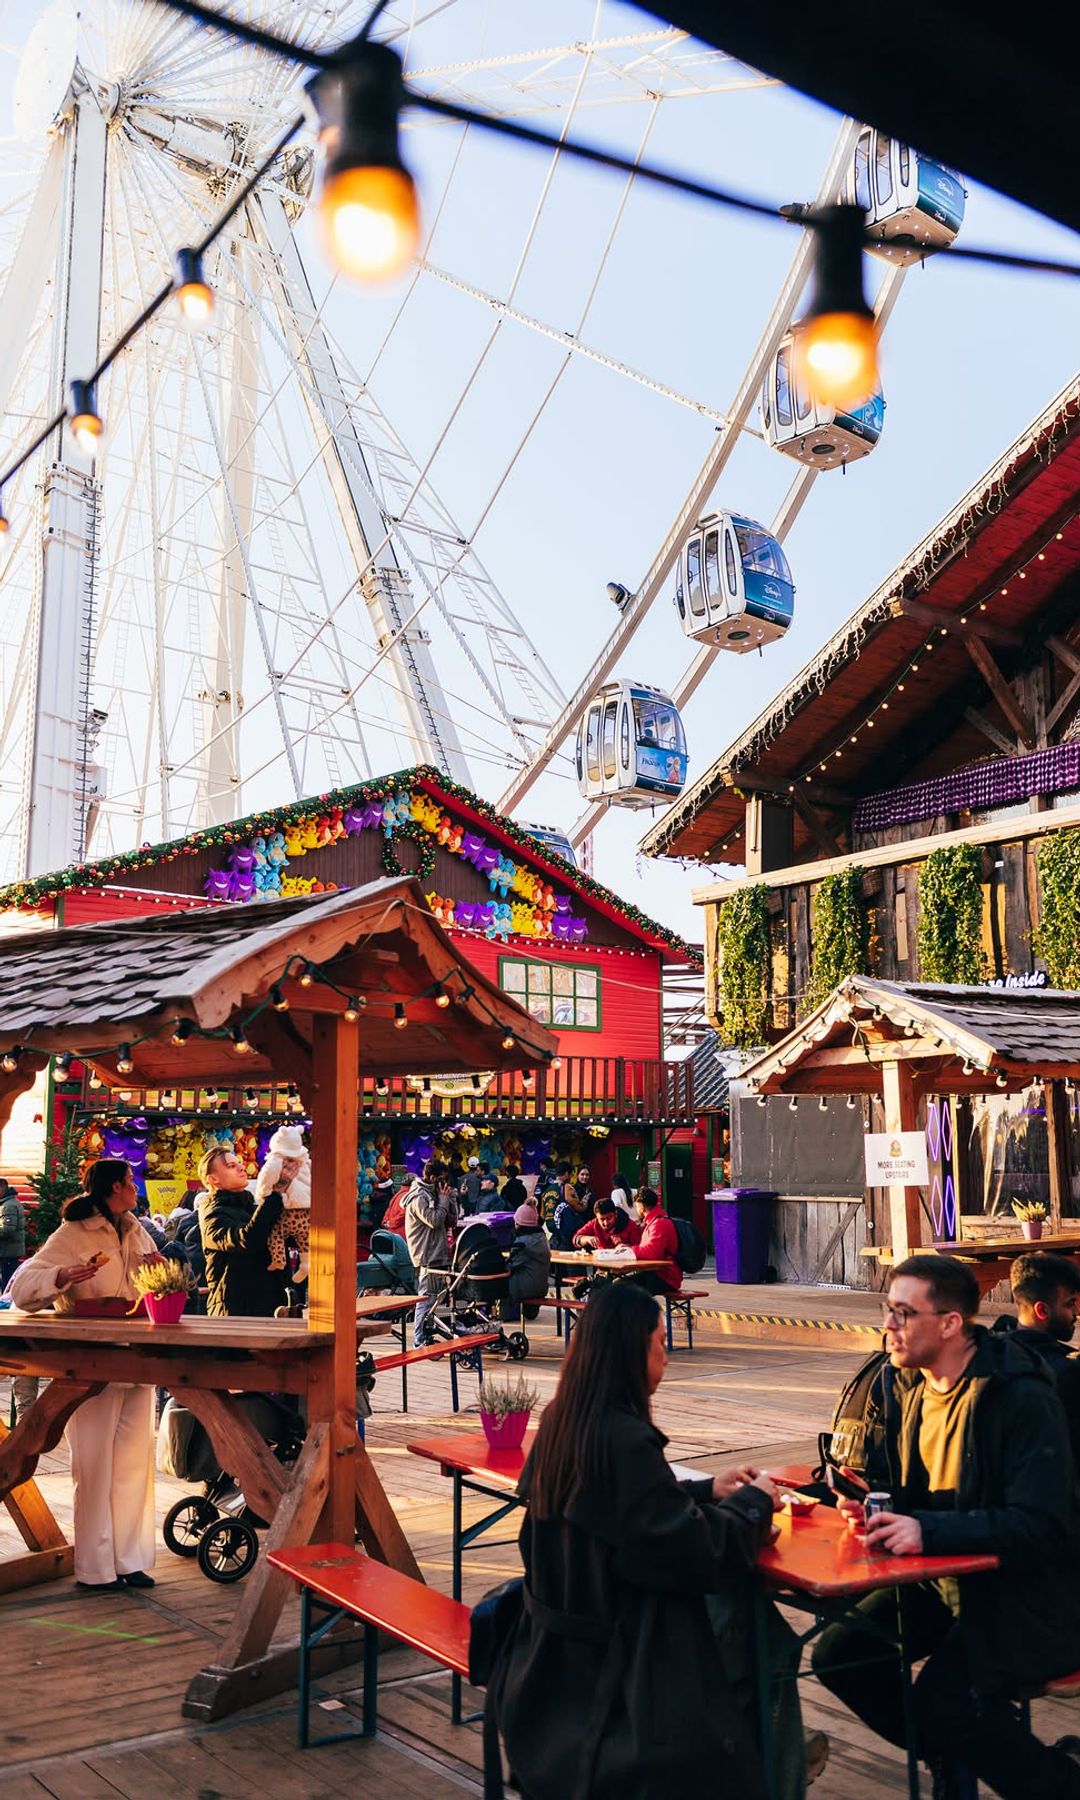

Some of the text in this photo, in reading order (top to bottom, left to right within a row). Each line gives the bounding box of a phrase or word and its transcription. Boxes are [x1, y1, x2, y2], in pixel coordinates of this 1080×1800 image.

[1005, 970, 1046, 988] Inside
[877, 1160, 916, 1169] MORE SEATING
